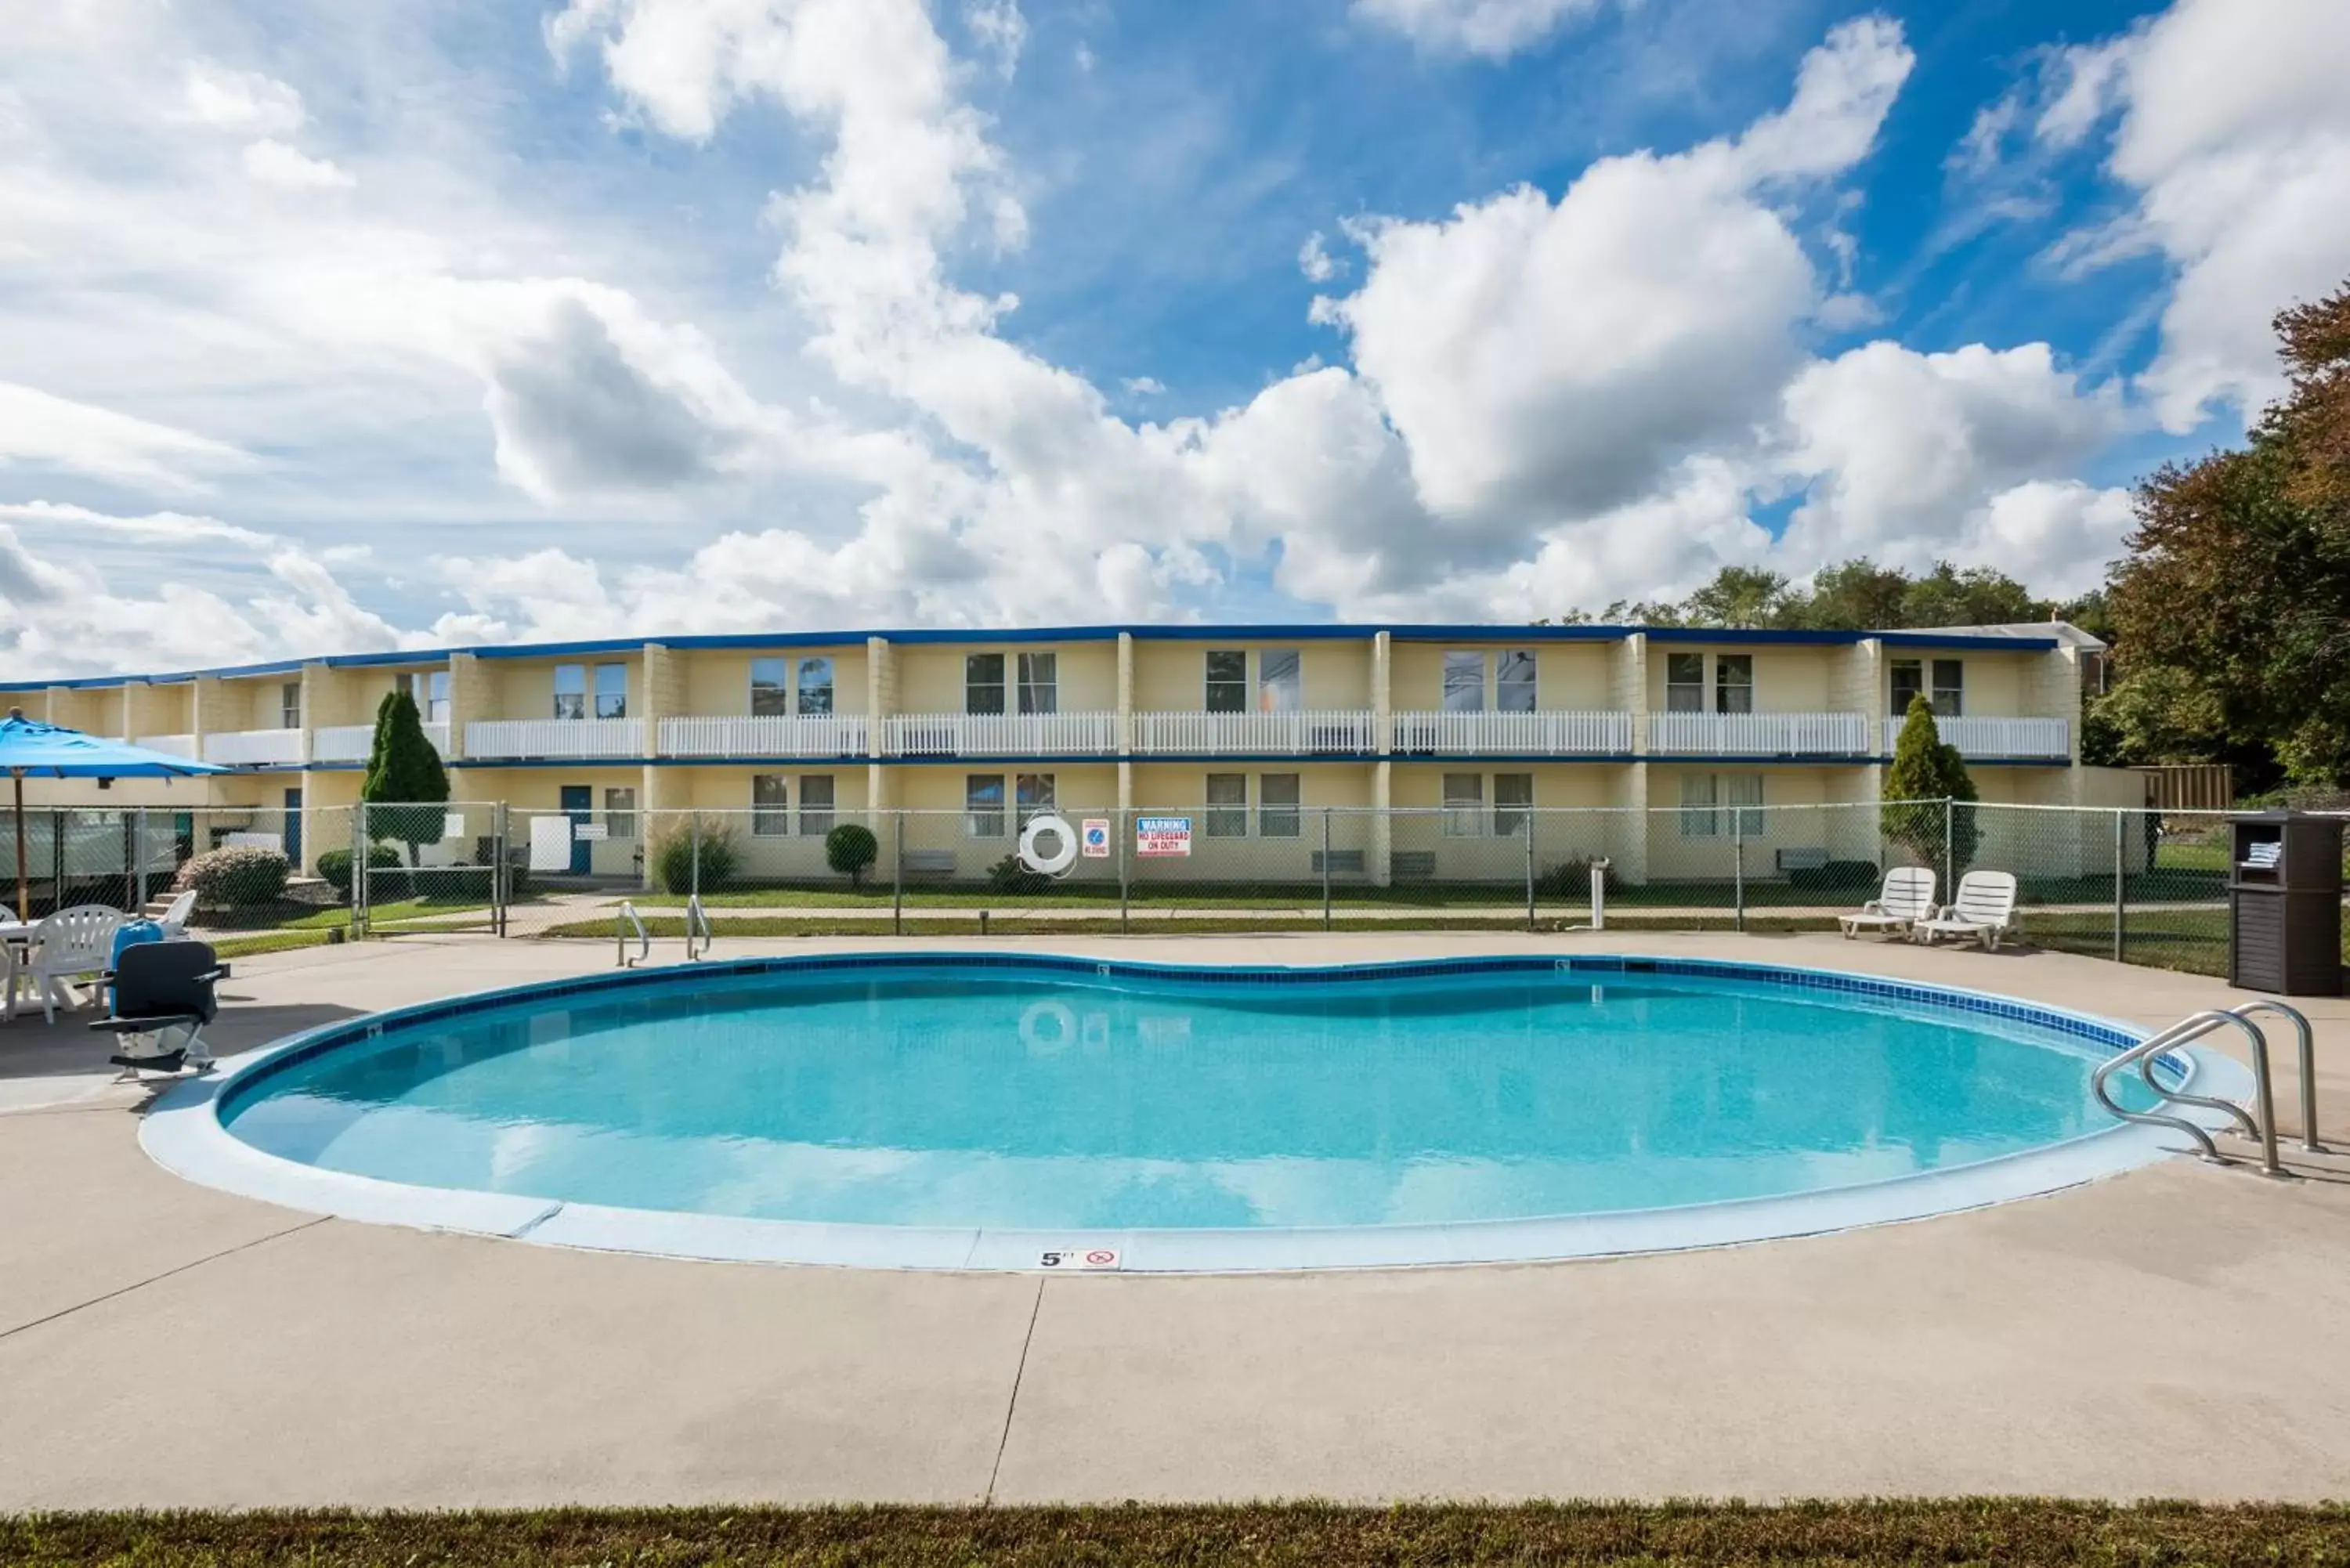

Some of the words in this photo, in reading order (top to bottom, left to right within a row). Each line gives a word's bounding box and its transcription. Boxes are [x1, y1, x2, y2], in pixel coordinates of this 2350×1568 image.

[1141, 820, 1187, 831] WARNING
[1139, 832, 1149, 840] NO
[1152, 832, 1188, 840] LIFEGUARD
[1148, 841, 1159, 850] ON
[1160, 840, 1178, 850] DUTY
